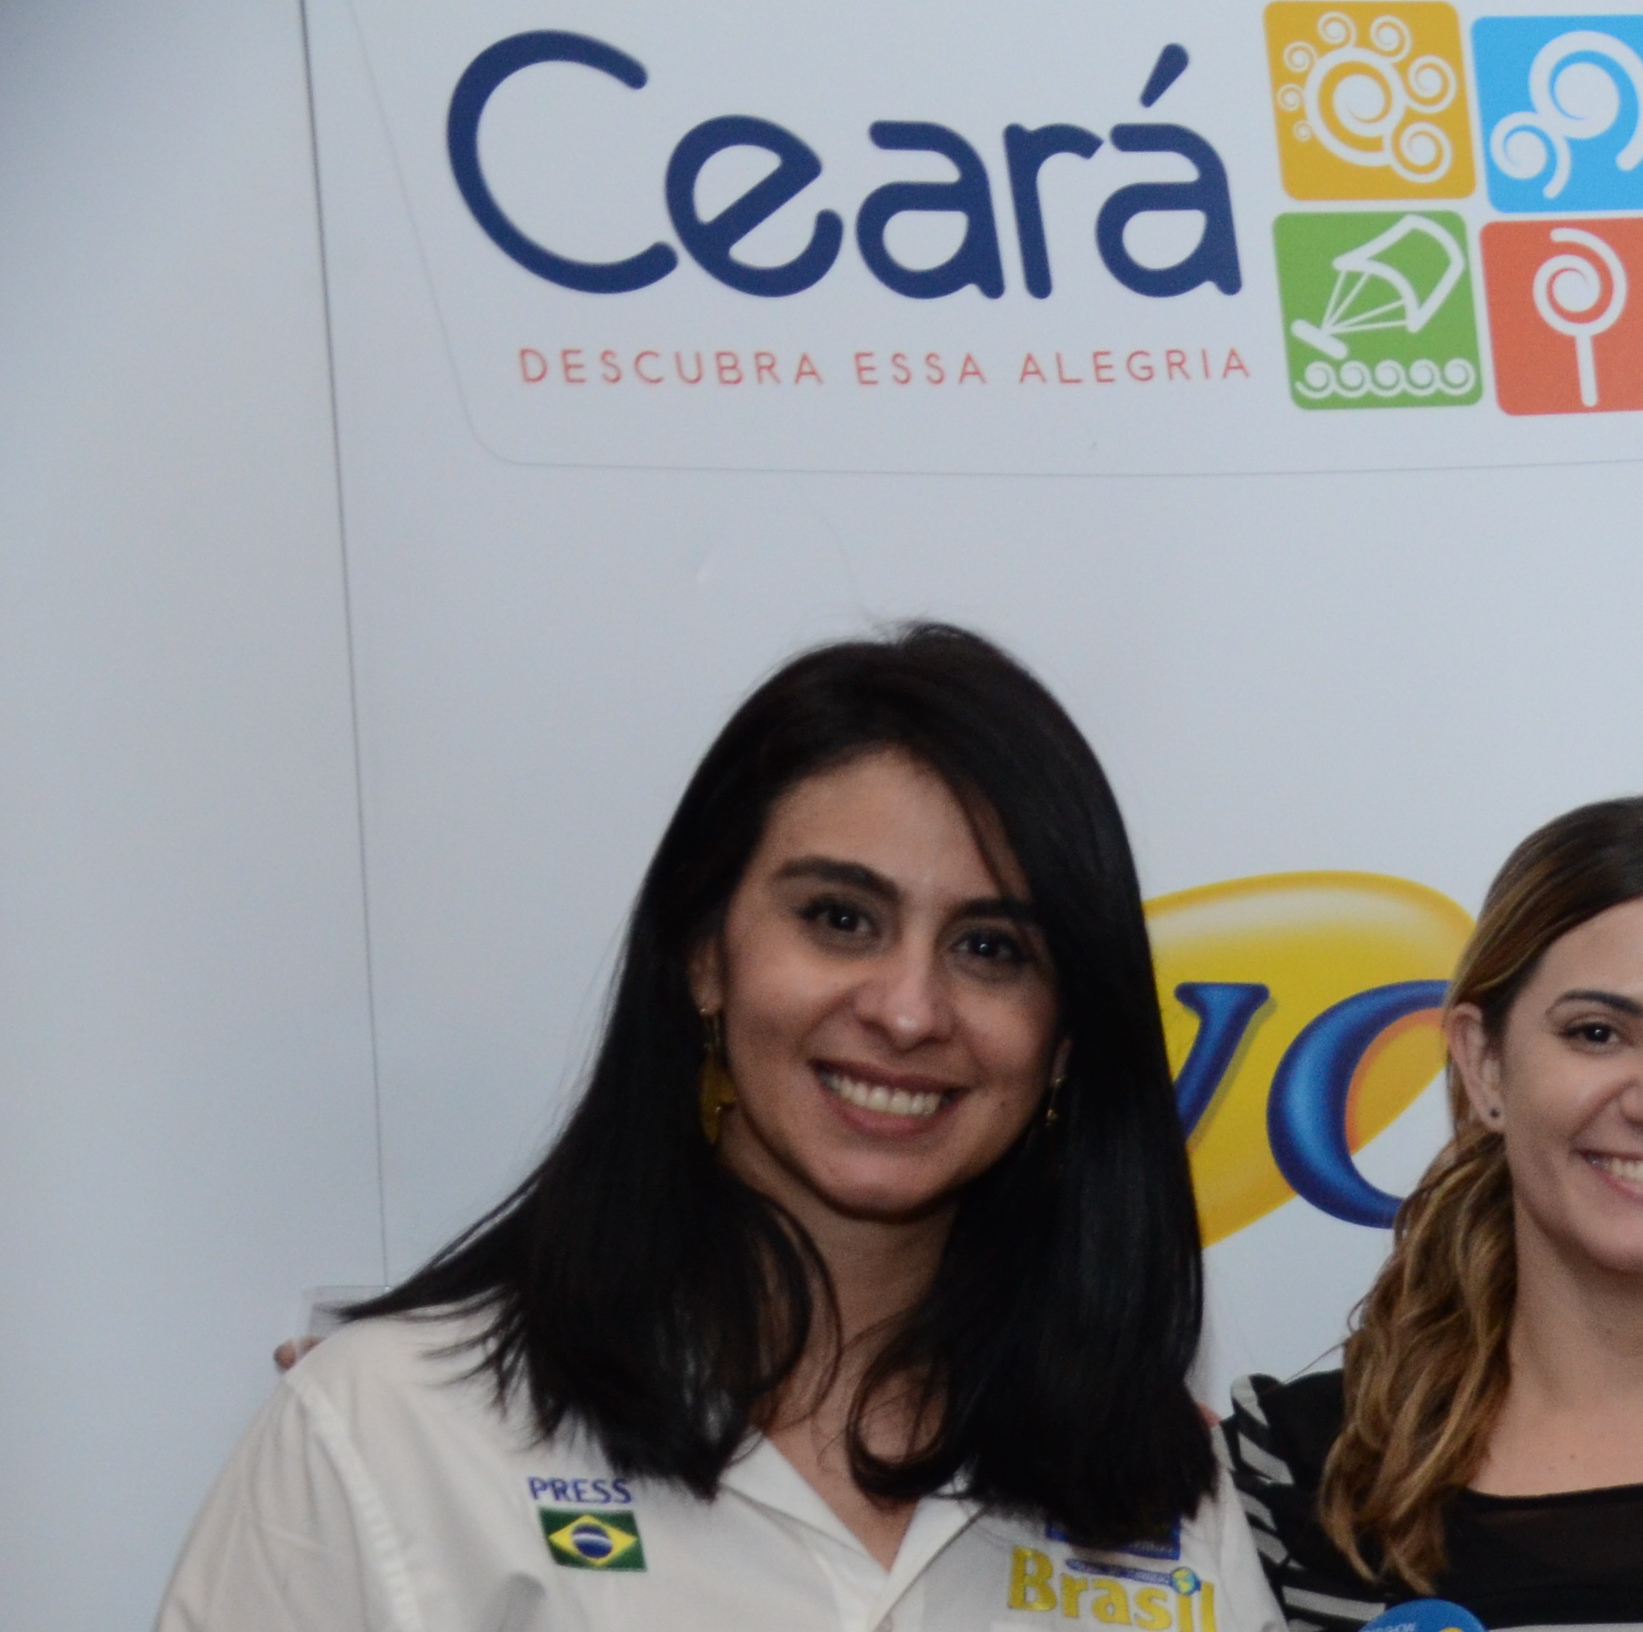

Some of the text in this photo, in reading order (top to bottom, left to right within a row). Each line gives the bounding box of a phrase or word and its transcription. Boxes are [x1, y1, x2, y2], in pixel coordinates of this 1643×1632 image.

[446, 30, 1242, 299] Ceará
[519, 347, 1251, 385] DESCUBRA ESSA ALEGRIA
[527, 1476, 632, 1504] PRESS
